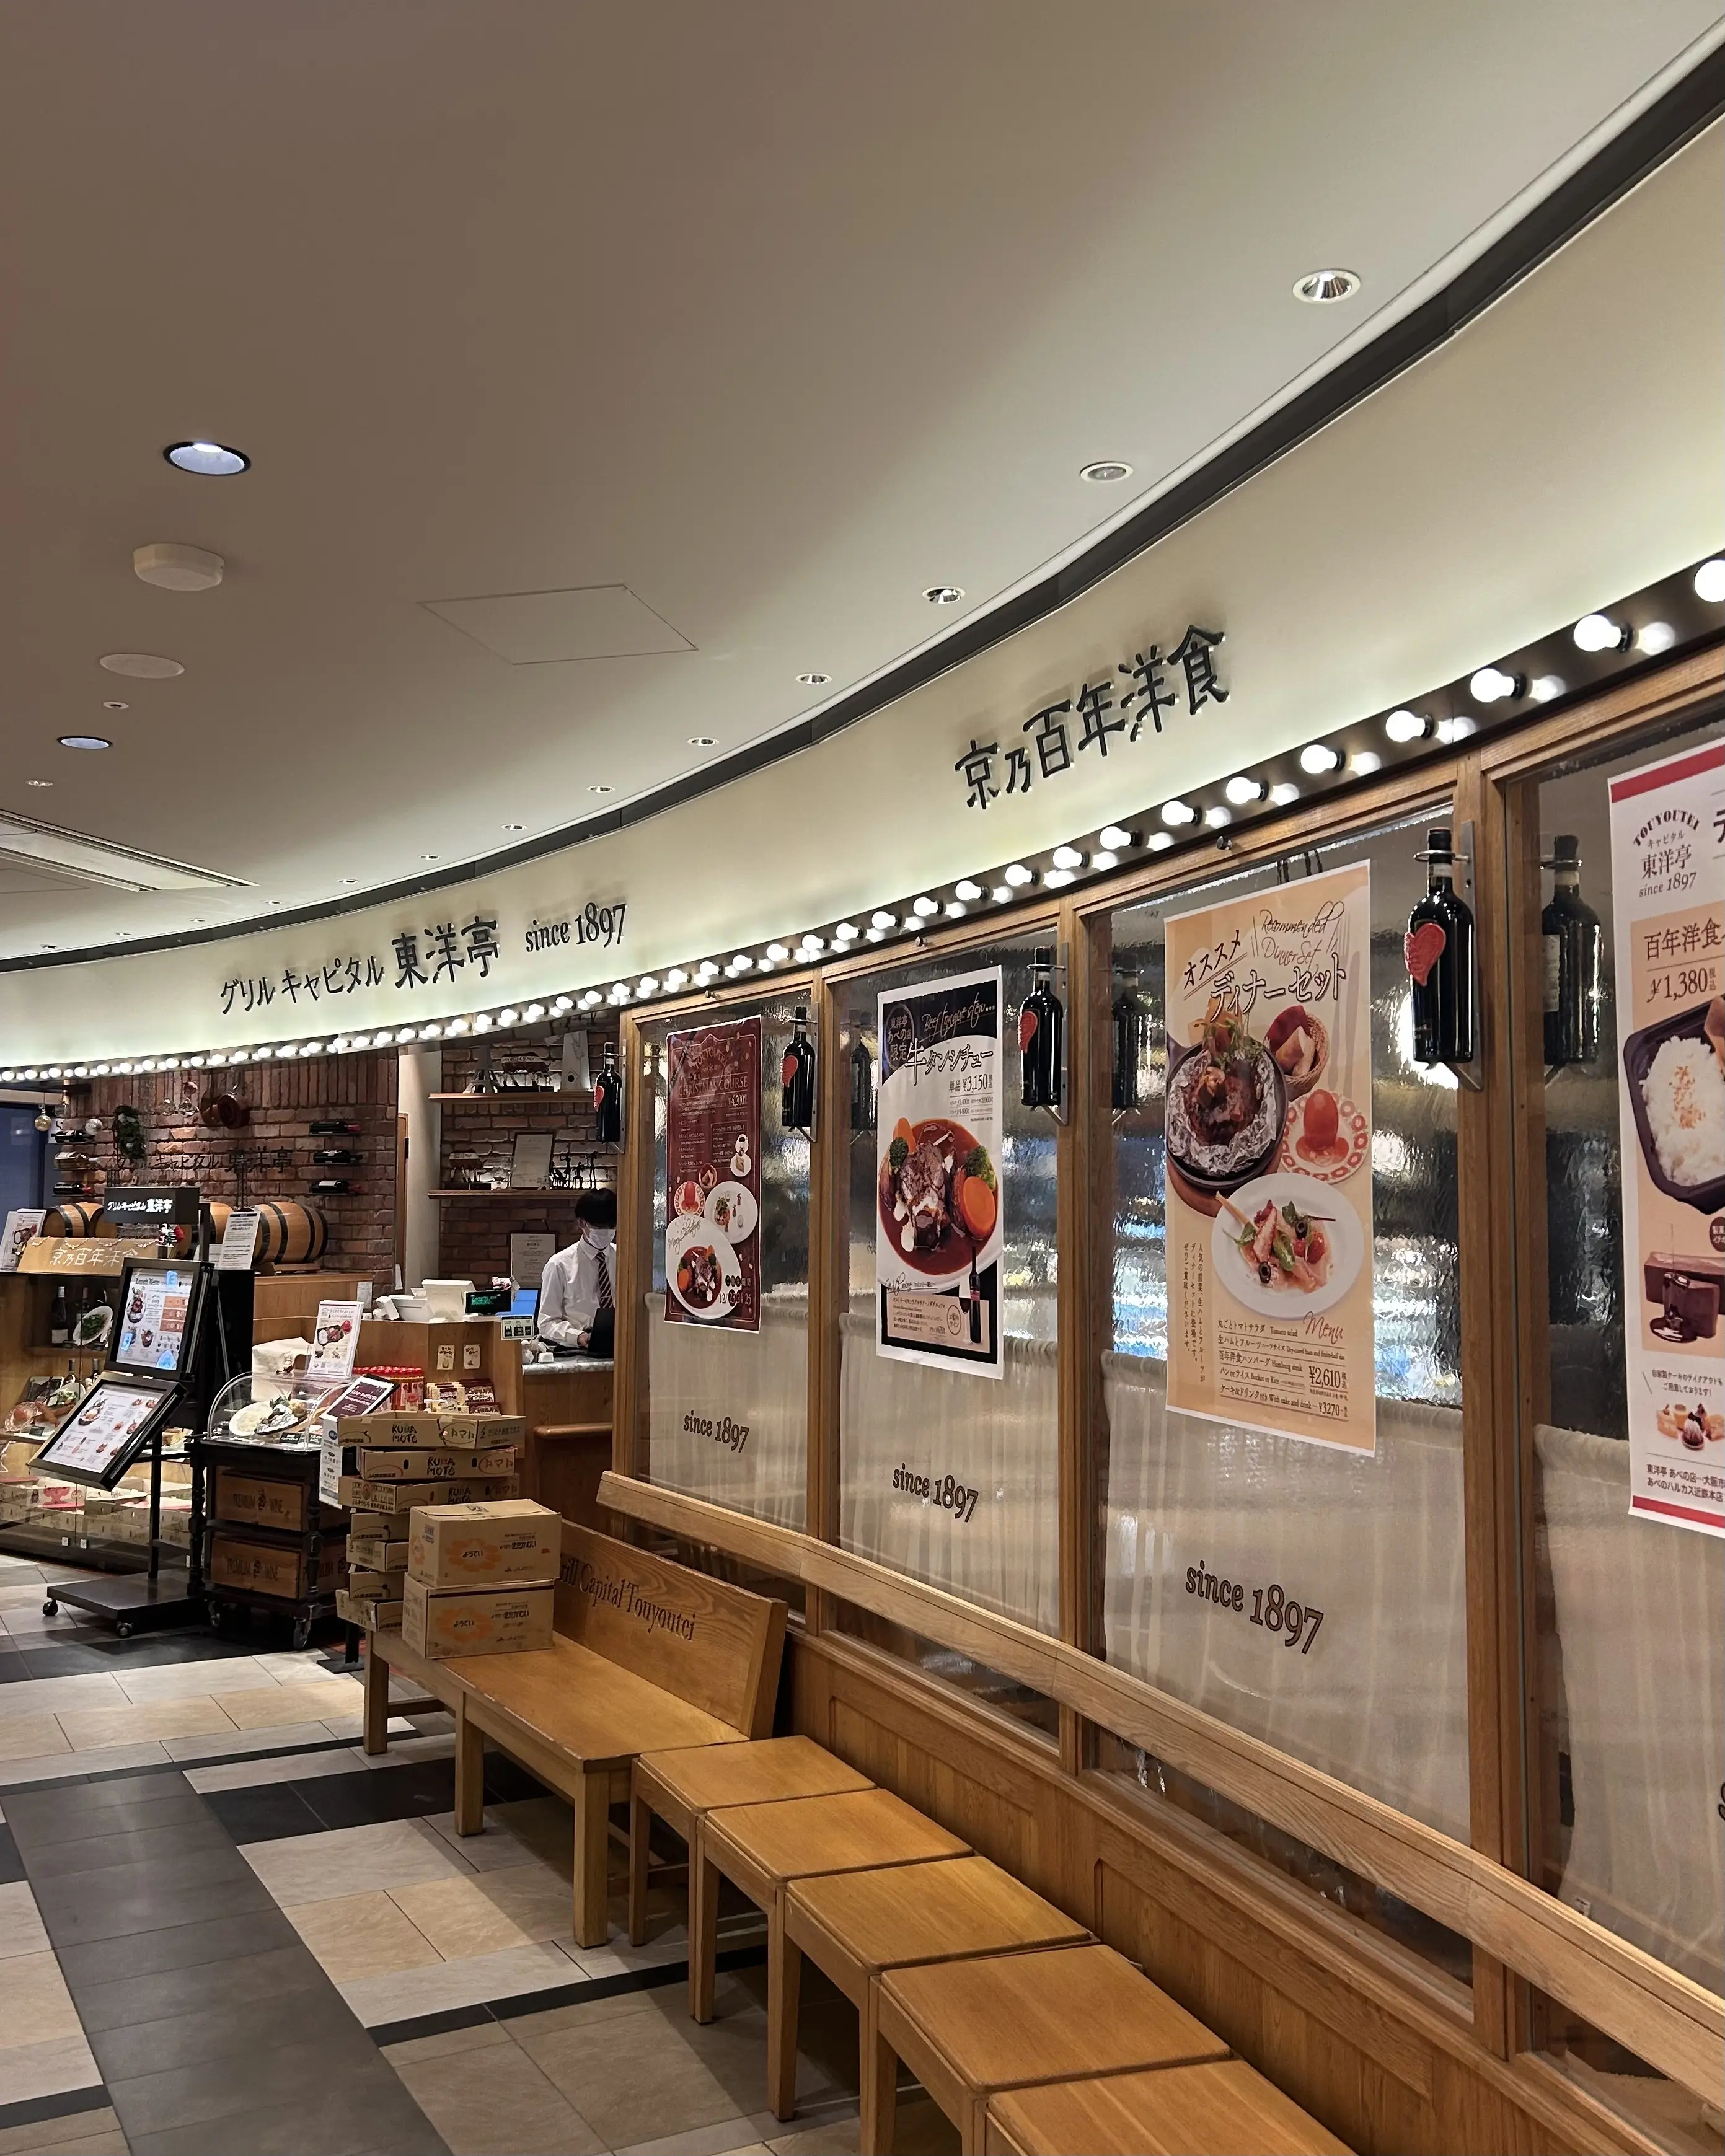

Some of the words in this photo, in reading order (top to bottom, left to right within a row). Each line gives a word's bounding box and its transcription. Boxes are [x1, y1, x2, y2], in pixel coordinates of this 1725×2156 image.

[955, 625, 1230, 809] 京乃百年洋食
[1633, 809, 1700, 847] TOUYOUTEI
[1641, 843, 1692, 879] 東洋亭
[1639, 883, 1664, 897] since
[1667, 872, 1697, 891] 1897
[220, 977, 276, 1014] グリル
[281, 956, 385, 1003] キャピタル
[391, 915, 500, 989] 東洋亭
[526, 920, 570, 953] since
[575, 902, 627, 948] 1897
[1644, 917, 1725, 961] 百年洋食
[1184, 930, 1241, 989] オススメ
[1211, 952, 1347, 1023] ディナーセット
[1646, 968, 1708, 1003] ¥1,380
[904, 1037, 994, 1086] 牛タンシチュー
[678, 1081, 717, 1096] CHRISTMAS
[719, 1076, 748, 1090] COURSE
[963, 1073, 988, 1093] ¥3,150
[1302, 1311, 1343, 1345] Menu
[1309, 1366, 1341, 1388] ¥2,610
[683, 1410, 713, 1437] since
[714, 1416, 749, 1453] 1897
[893, 1463, 930, 1498] since
[932, 1475, 979, 1523] 1897
[462, 1550, 483, 1559] ようてい
[560, 1554, 579, 1587] rill
[580, 1562, 625, 1608] Capital
[625, 1579, 696, 1642] Touyoutei
[1185, 1560, 1244, 1612] since
[1250, 1584, 1324, 1655] 1897
[453, 1619, 474, 1628] ようてい
